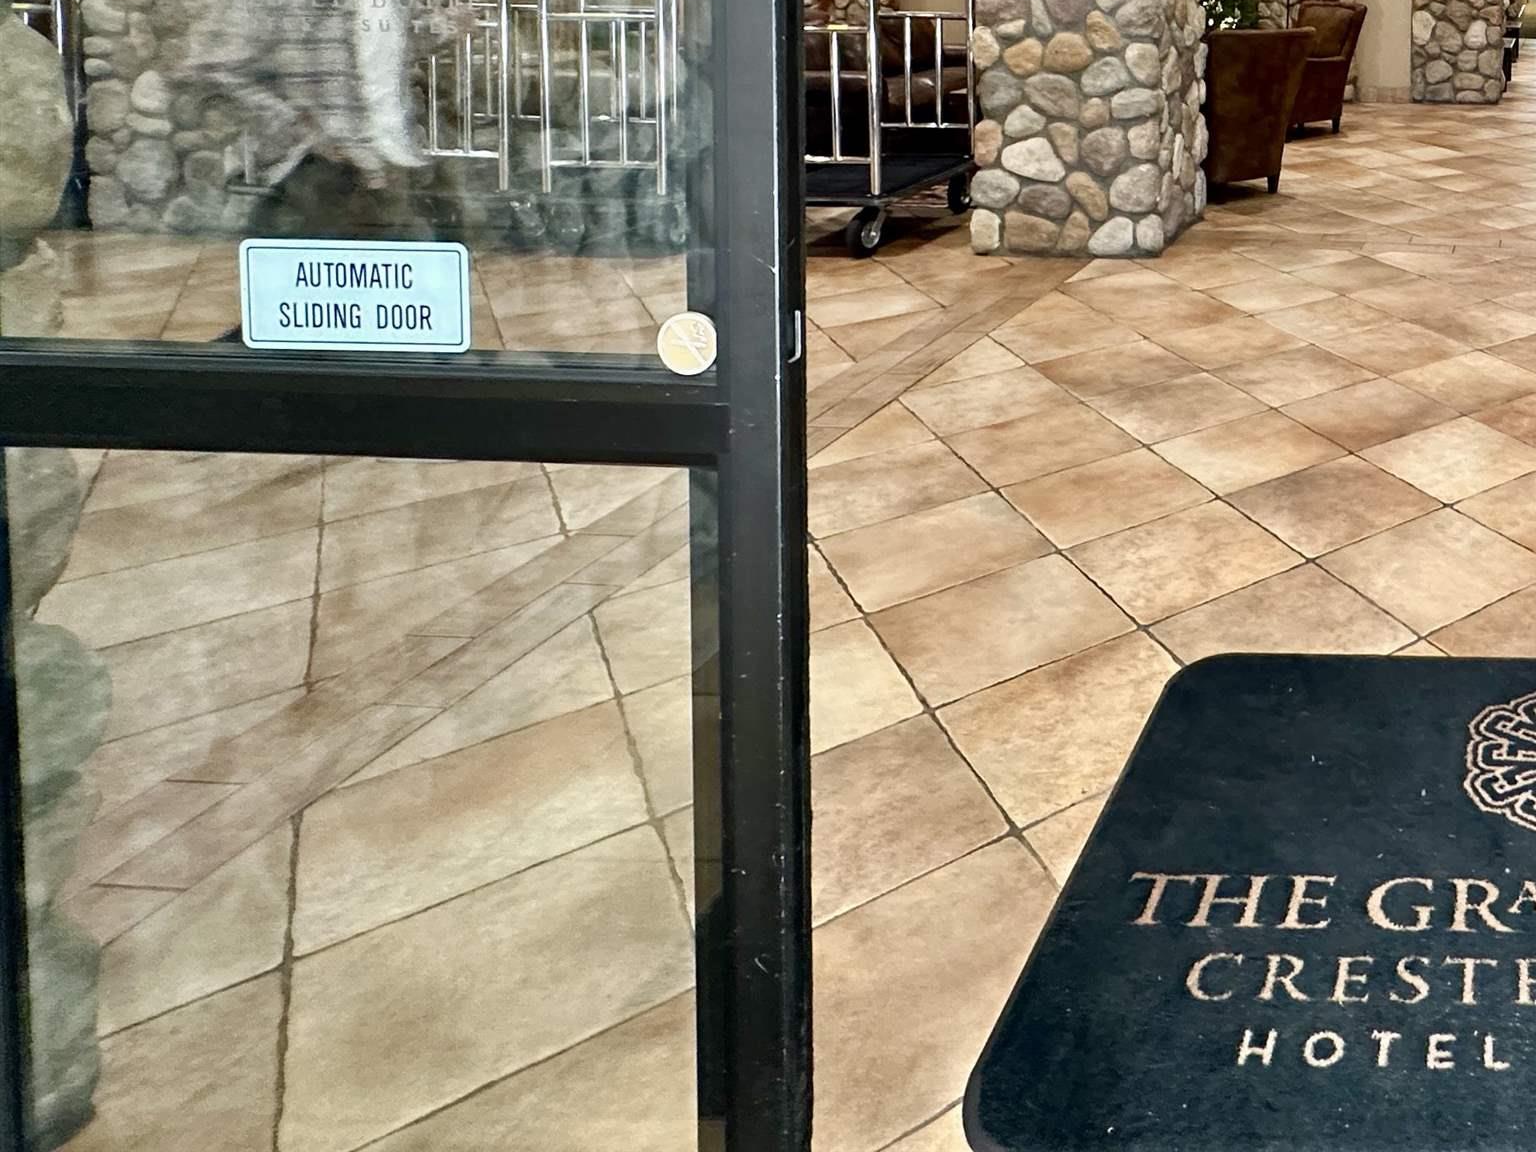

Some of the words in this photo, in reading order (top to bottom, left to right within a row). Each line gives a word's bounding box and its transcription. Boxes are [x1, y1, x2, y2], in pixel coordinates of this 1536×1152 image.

[361, 18, 458, 35] SUTES
[295, 261, 414, 290] AUTOMATIC
[279, 301, 362, 330] SLIDING
[376, 303, 433, 331] DOOR
[1130, 871, 1338, 931] THE
[1236, 1027, 1511, 1072] HOTEL
